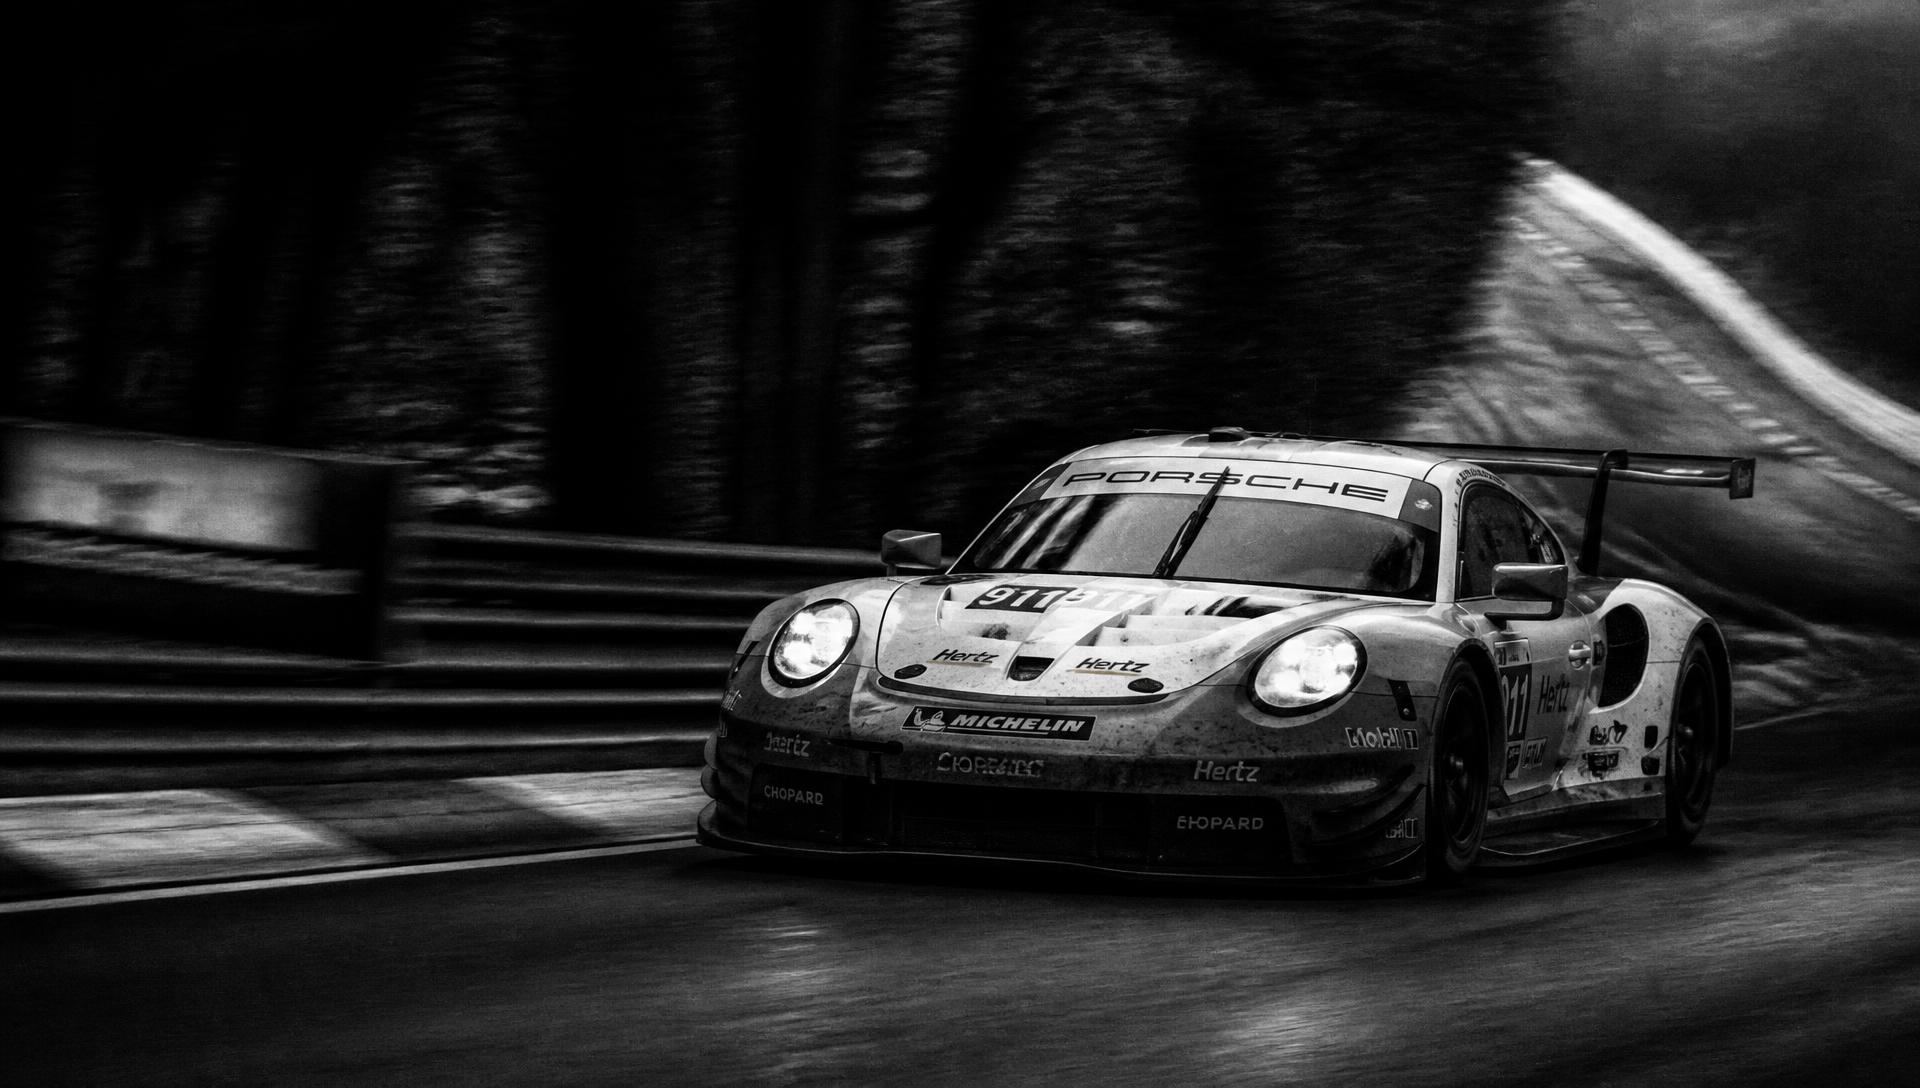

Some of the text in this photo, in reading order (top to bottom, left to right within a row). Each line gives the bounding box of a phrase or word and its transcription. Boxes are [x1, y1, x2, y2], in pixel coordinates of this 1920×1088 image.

[1063, 470, 1388, 502] PORSCHE
[978, 586, 1067, 609] 911
[932, 648, 999, 664] Hertz
[1076, 657, 1150, 673] Hertz
[950, 713, 1086, 733] MICHELIN
[1194, 760, 1261, 782] Hertz
[763, 784, 824, 806] CHOPARD
